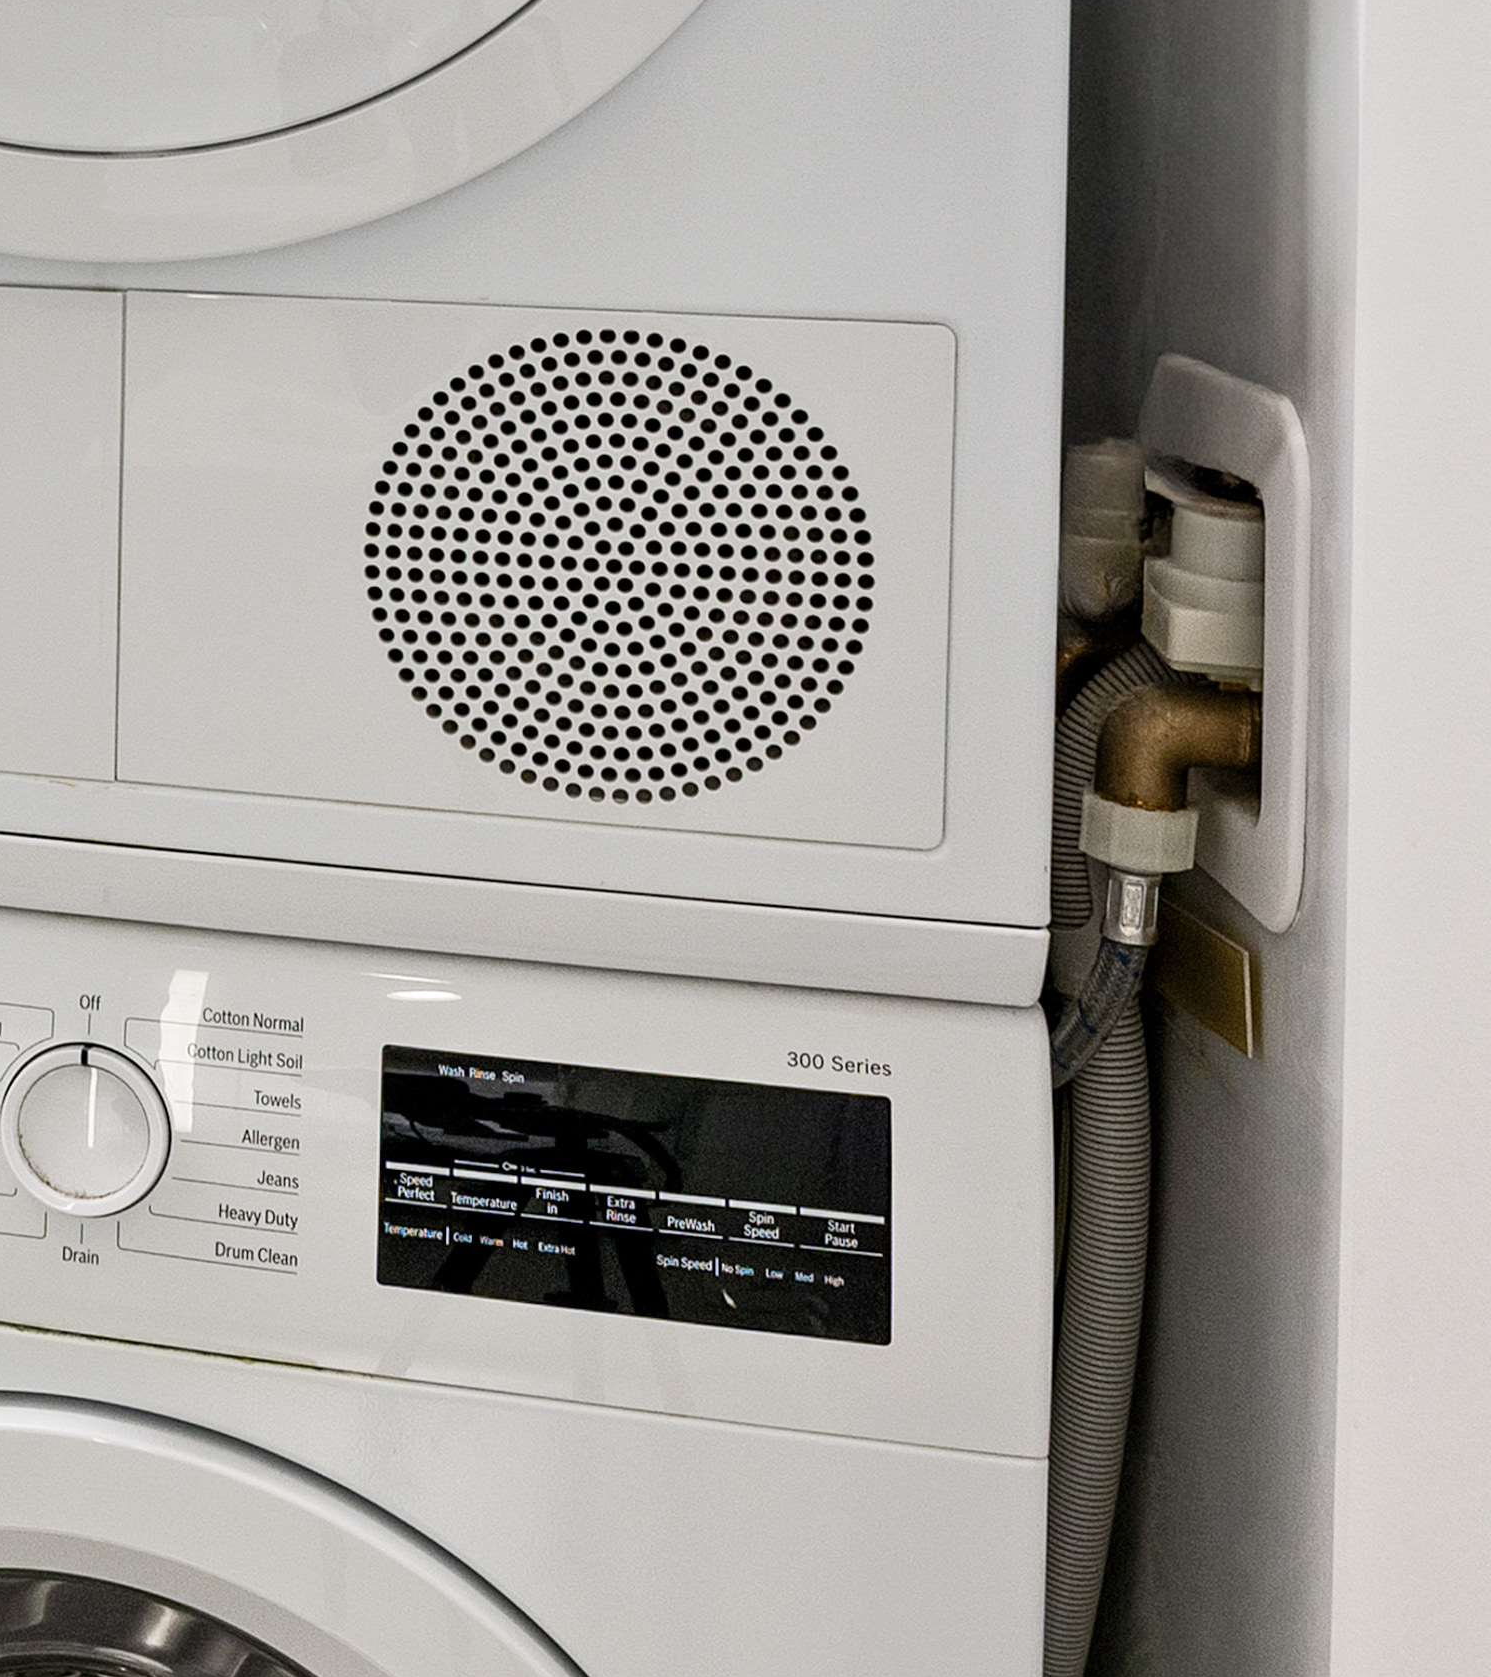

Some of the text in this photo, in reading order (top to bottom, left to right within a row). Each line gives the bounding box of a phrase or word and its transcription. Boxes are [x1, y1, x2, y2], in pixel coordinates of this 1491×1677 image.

[80, 995, 101, 1010] Off
[203, 1007, 304, 1032] Cotton Normal
[187, 1043, 302, 1069] Cotton Light Soil
[787, 1052, 892, 1076] 300 Series
[438, 1064, 524, 1083] Wash Rinse Spin
[254, 1090, 301, 1109] Towels
[242, 1130, 300, 1150] Allergen
[258, 1170, 299, 1189] Jeans
[399, 1173, 433, 1188] Speed
[397, 1186, 434, 1201] Perfect
[451, 1192, 517, 1211] Temperature
[536, 1188, 569, 1202] Finish
[547, 1204, 558, 1215] in
[607, 1196, 635, 1210] Extra
[219, 1204, 298, 1230] Heavy Duty
[606, 1210, 636, 1223] Rinse
[667, 1216, 715, 1232] PreWash
[749, 1211, 774, 1225] Spin
[744, 1225, 779, 1239] Speed
[828, 1220, 855, 1234] Start
[385, 1222, 575, 1255] Temperature Cold Warm Hot Extra Hot
[825, 1234, 858, 1248] Pause
[63, 1247, 99, 1264] Drain
[215, 1242, 298, 1267] Drum Clean
[657, 1254, 844, 1287] Spin Speed No Spin Low Med High
